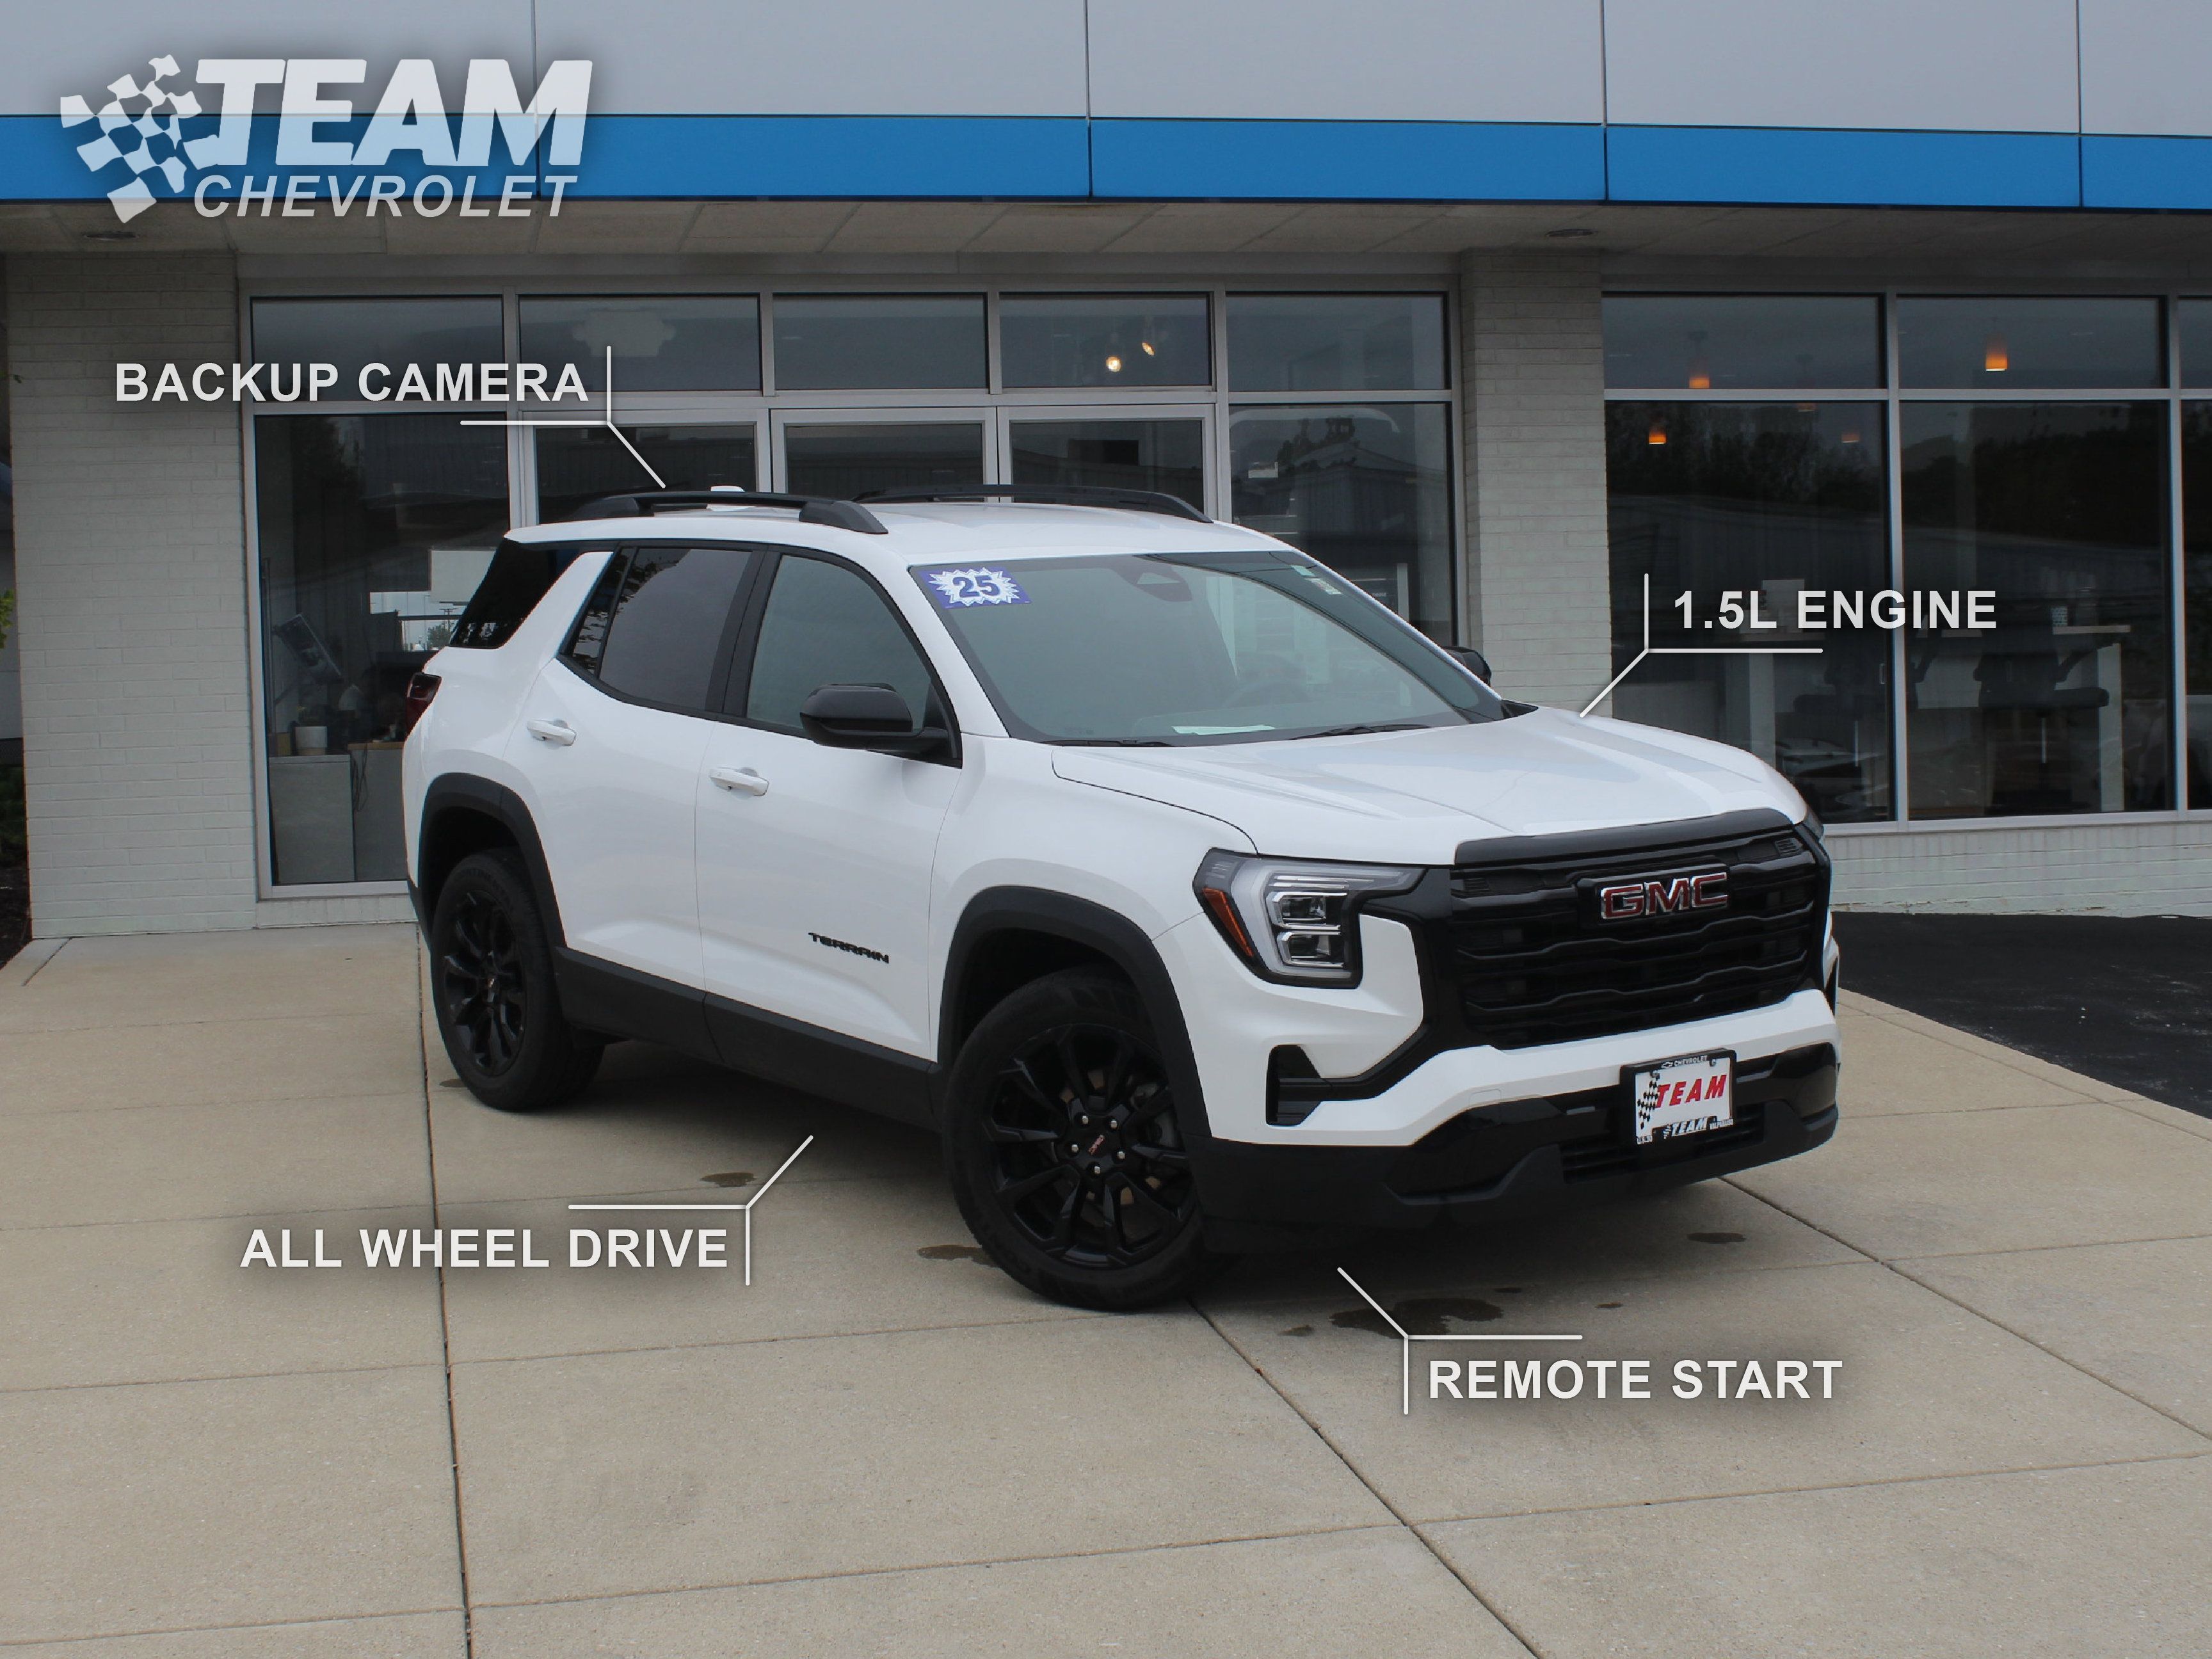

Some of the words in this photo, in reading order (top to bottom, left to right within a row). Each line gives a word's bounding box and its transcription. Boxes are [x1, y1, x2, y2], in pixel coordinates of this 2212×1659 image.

[952, 575, 1000, 598] 25
[1600, 872, 1729, 919] GMC
[1655, 1075, 1727, 1109] TEAM
[1671, 1117, 1708, 1137] TEAM
